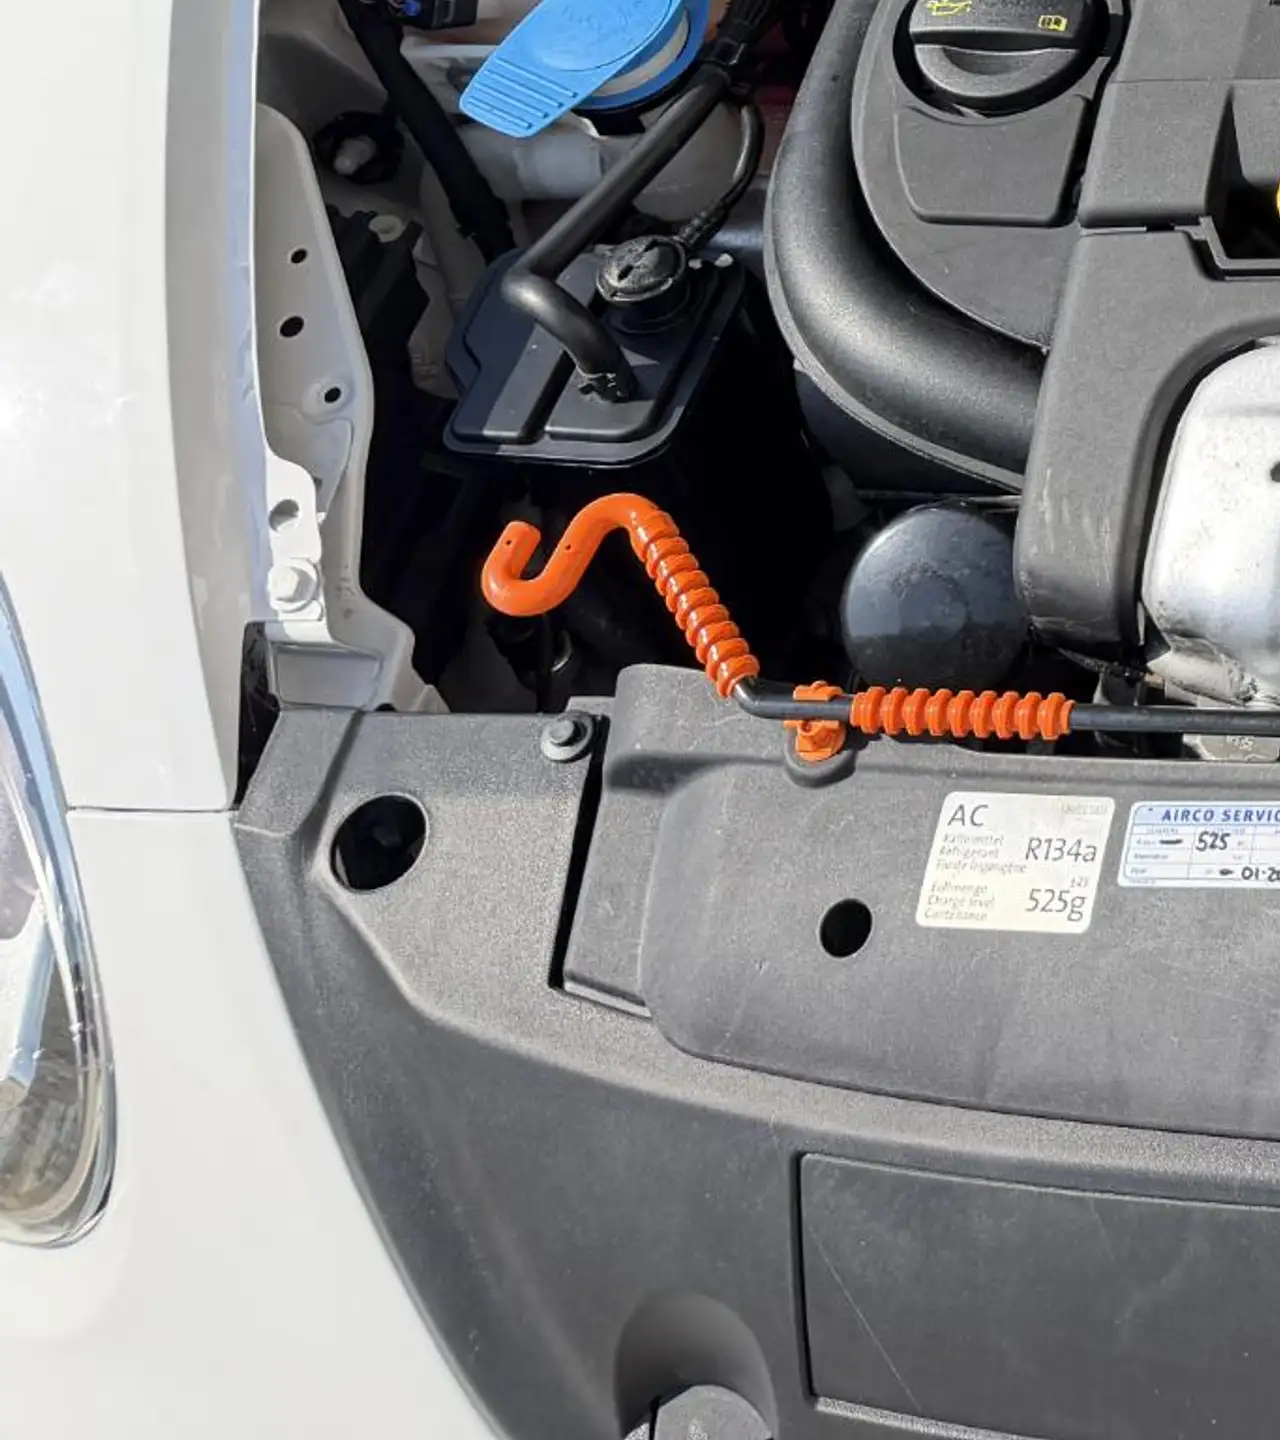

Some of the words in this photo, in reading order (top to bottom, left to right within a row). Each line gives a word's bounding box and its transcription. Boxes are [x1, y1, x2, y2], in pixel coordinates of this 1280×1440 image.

[947, 803, 989, 827] AC
[1161, 808, 1215, 823] AIRCO
[1025, 836, 1098, 863] R134a
[1195, 830, 1231, 852] 525
[1024, 888, 1088, 923] 525g
